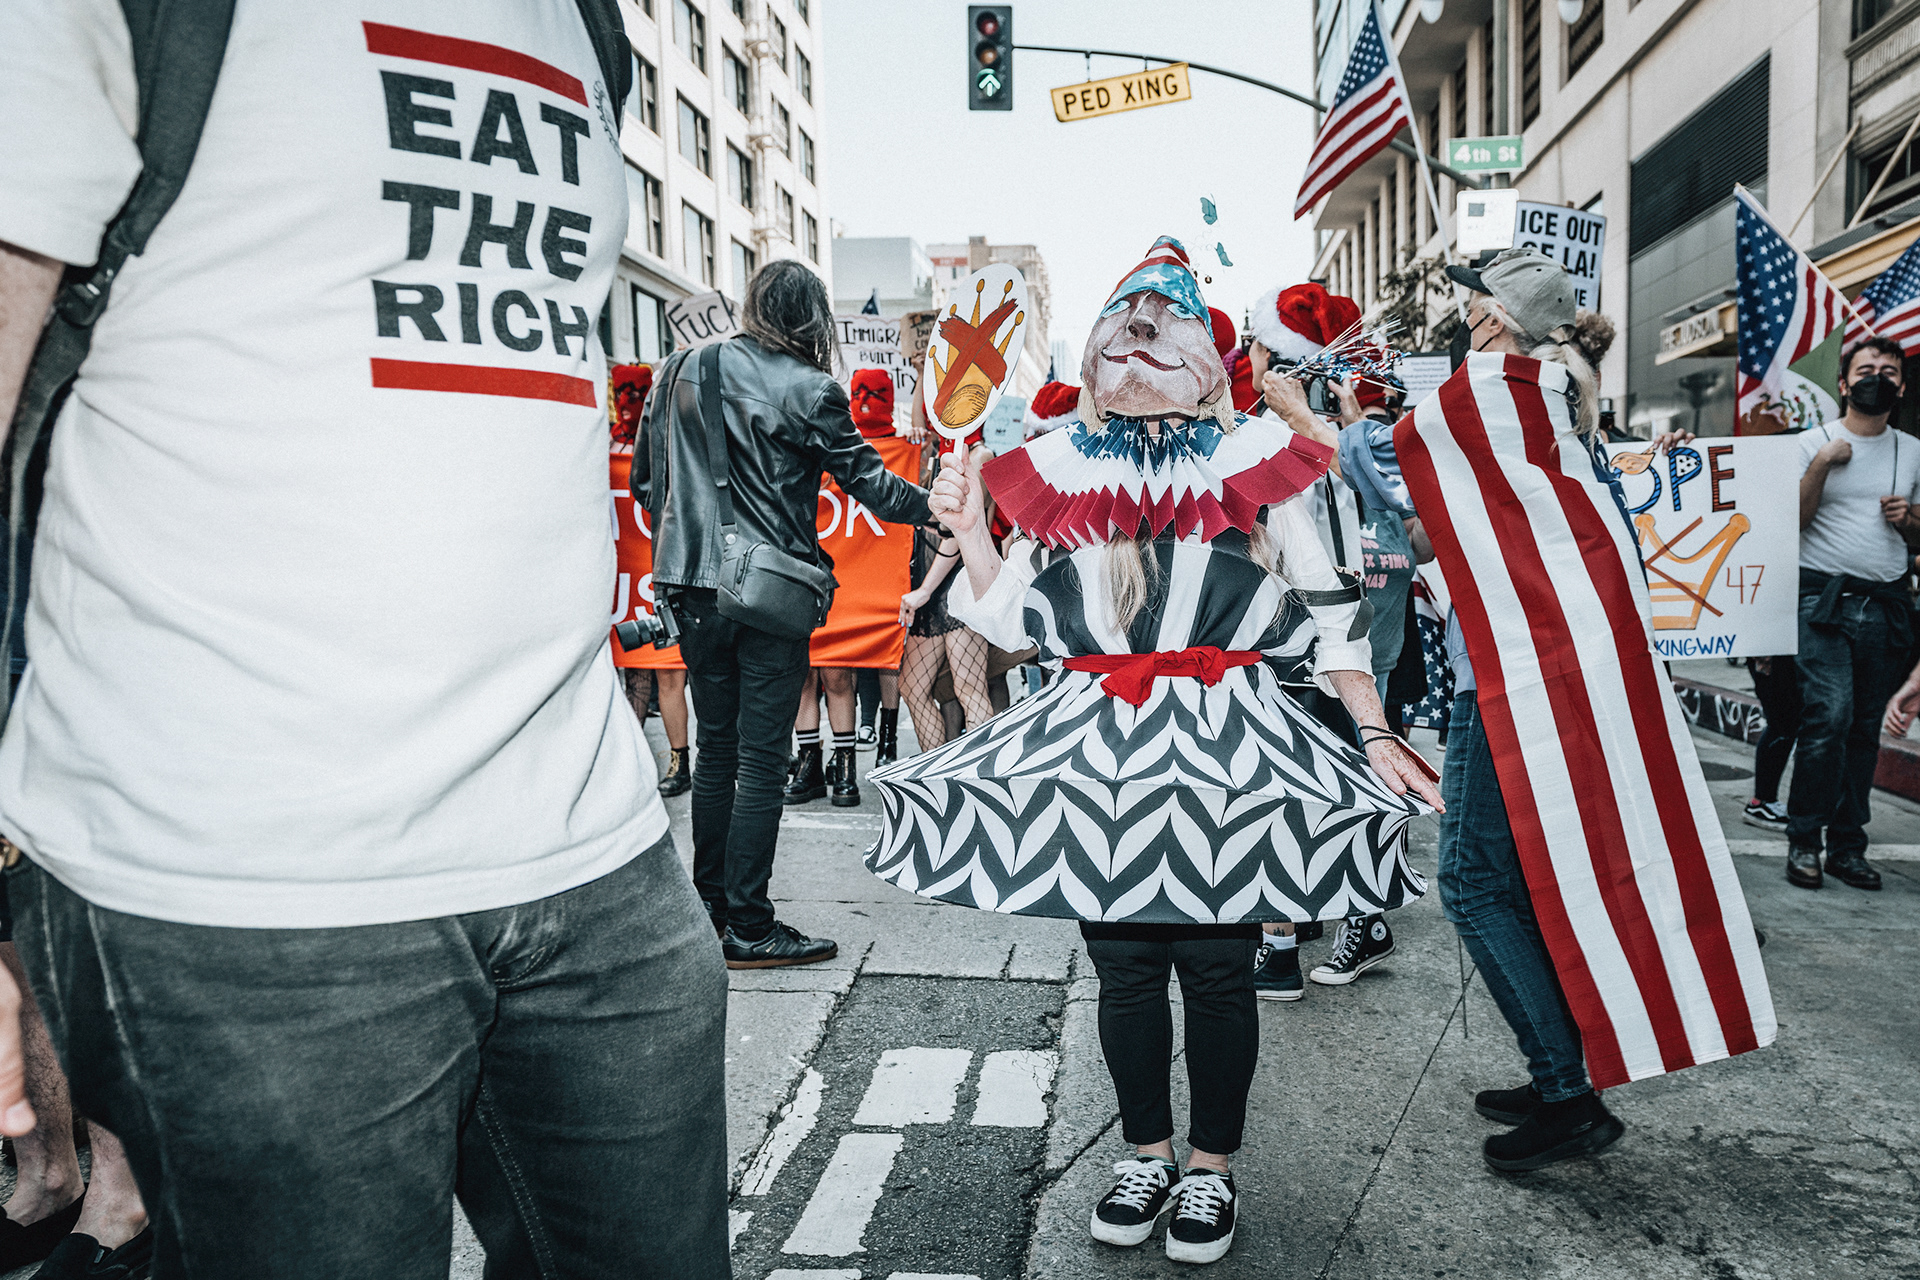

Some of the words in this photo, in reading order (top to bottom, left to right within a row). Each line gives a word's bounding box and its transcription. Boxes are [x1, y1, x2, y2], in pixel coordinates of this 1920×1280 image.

[1063, 87, 1111, 115] PED
[1122, 73, 1178, 104] XING
[379, 69, 591, 186] EAT
[1454, 144, 1491, 164] 4th
[1498, 145, 1517, 162] St
[381, 179, 592, 282] THE
[1520, 209, 1558, 236] ICE
[1566, 216, 1603, 246] OUT
[1563, 247, 1596, 279] LA!
[371, 279, 590, 361] RICH
[860, 351, 894, 364] BUILT
[1727, 565, 1764, 604] 47
